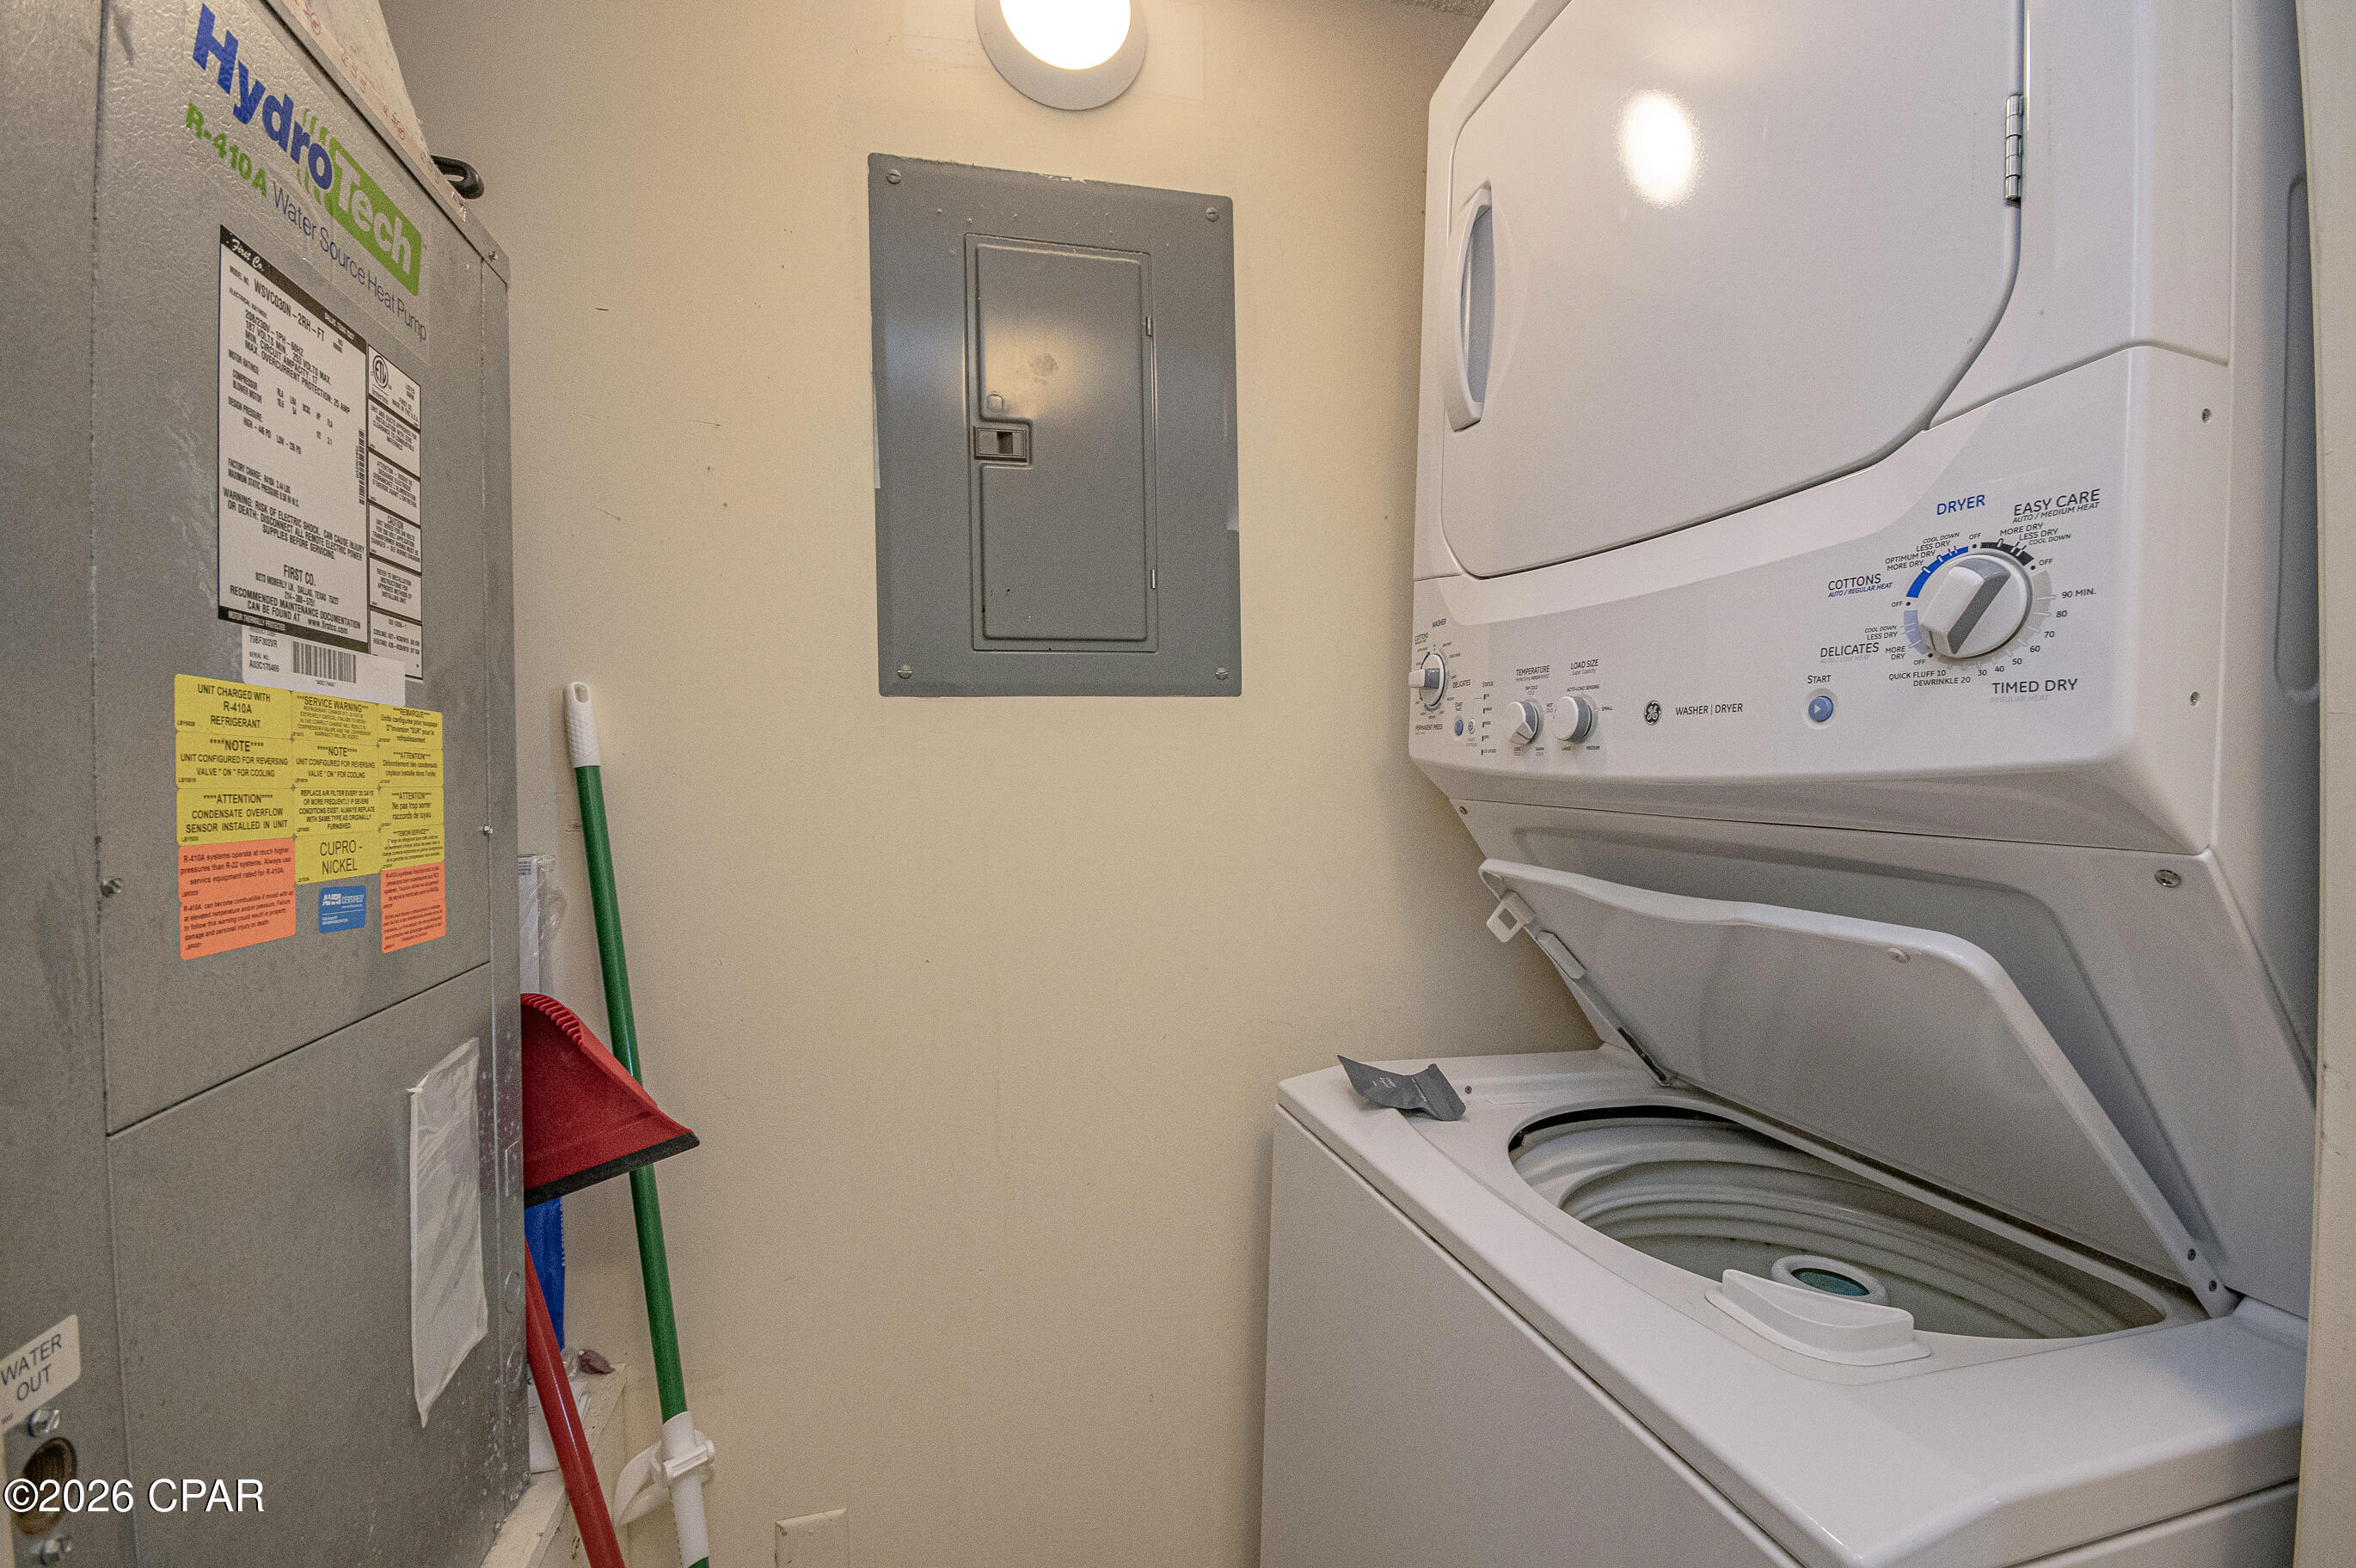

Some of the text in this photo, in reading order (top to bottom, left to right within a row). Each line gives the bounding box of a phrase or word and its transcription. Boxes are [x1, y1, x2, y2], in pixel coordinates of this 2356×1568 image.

[185, 102, 267, 198] R-410A
[273, 181, 317, 240] Water
[320, 227, 365, 285] Source
[368, 271, 396, 314] Heat
[397, 299, 427, 343] Pump
[223, 487, 254, 508] WARNING:
[255, 500, 268, 512] RISK
[269, 506, 277, 517] OF
[278, 510, 302, 528] ELECTRIC
[1936, 494, 1985, 517] DRYER
[2014, 488, 2101, 516] EASY CARE
[227, 499, 236, 511] OR
[260, 512, 293, 534] DISCONNECT
[294, 527, 304, 539] ALL
[2011, 514, 2034, 524] AUTO
[2040, 507, 2075, 519] MEDIUM
[2076, 501, 2101, 512] HEAT
[2000, 523, 2044, 536] MORE DRY
[2019, 528, 2059, 542] LESS DRY
[262, 524, 289, 543] SUPPLIES
[289, 534, 309, 550] BEFORE
[1939, 532, 1960, 542] DOWN
[2047, 533, 2071, 543] DOWN
[1916, 539, 1952, 553] LESS DRY
[1885, 549, 1936, 565] OPTIMUM DRY
[2039, 558, 2053, 567] OFF
[1887, 559, 1925, 572] MORE DRY
[283, 564, 316, 587] FIRST CO.
[1827, 573, 1882, 591] COTTONS
[1848, 585, 1875, 595] REGULAR
[1875, 582, 1893, 591] HEAT
[2061, 588, 2096, 599] 90 MIN.
[230, 585, 361, 630] RECOMMENDED MAINTENANCE DOCUMENTATION
[247, 600, 261, 611] CAN
[261, 603, 270, 615] BE
[272, 606, 292, 620] FOUND
[292, 612, 301, 622] AT
[1820, 642, 1880, 658] DELICATES
[1885, 646, 1905, 654] MORE
[1516, 665, 1550, 677] TEMPERATURE
[1570, 658, 1599, 671] LOAD SIZE
[1807, 675, 1831, 684] START
[1888, 672, 1911, 681] QUICK
[1913, 677, 1959, 687] DEWRINKLE
[1452, 679, 1471, 689] DELICATES
[1991, 678, 2078, 694] TIMED DRY
[197, 683, 271, 701] UNIT CHARGED WITH
[223, 701, 253, 714] R-410A
[1675, 706, 1709, 715] WASHER
[1715, 703, 1744, 714] DRYER
[210, 715, 261, 728] REFRIGERANT
[180, 753, 289, 766] UNIT CONFIGURED FOR REVERSING
[296, 757, 309, 766] UNIT
[309, 758, 340, 768] CONFIGURED
[196, 767, 218, 776] VALVE
[250, 769, 275, 778] COOLING
[191, 807, 284, 819] CONDENSATE OVERFLOW
[185, 819, 288, 834] SENSOR INSTALLED IN UNIT
[319, 839, 357, 856] CUPRO
[180, 866, 211, 876] pressures
[322, 857, 359, 875] NICKEL
[1, 1333, 62, 1386] WATER
[17, 1364, 52, 1401] OUT
